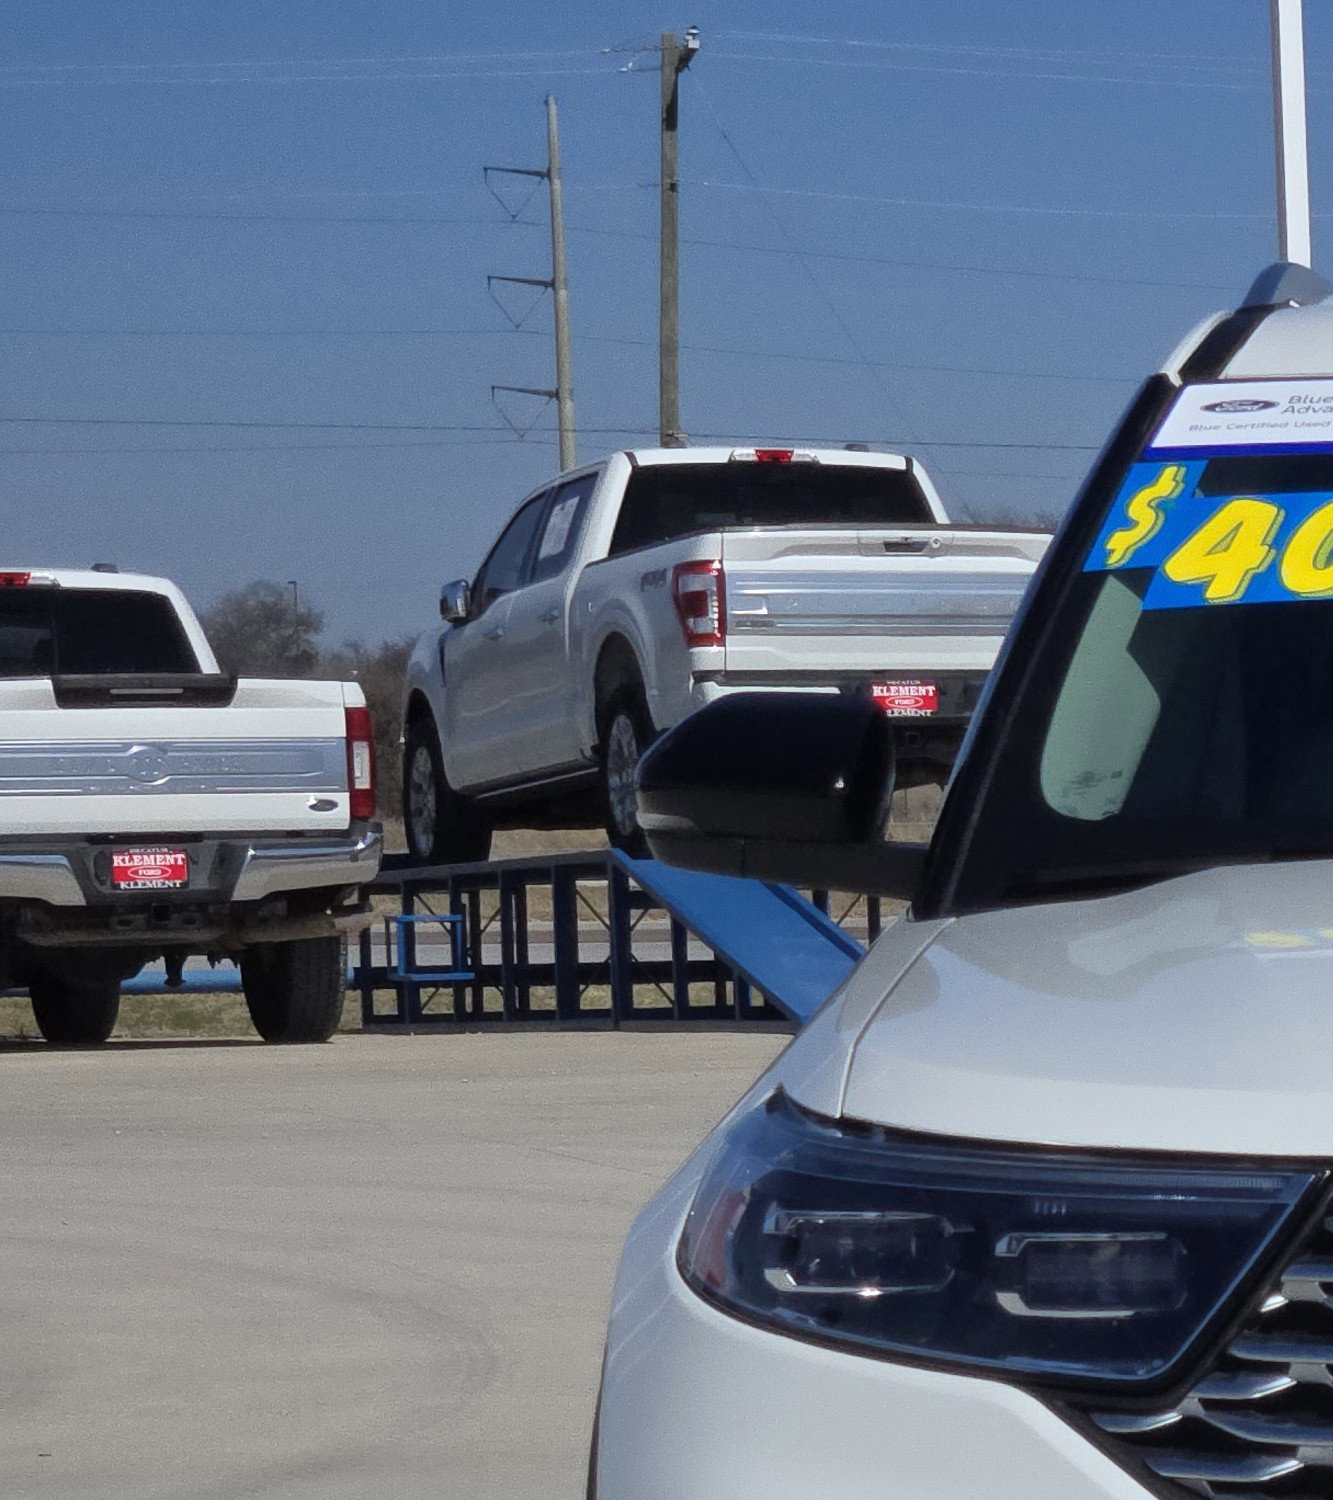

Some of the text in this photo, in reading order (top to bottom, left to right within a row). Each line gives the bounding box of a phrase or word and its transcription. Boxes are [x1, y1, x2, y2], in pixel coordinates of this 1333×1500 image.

[1226, 420, 1288, 430] Certified
[1293, 419, 1332, 429] Used
[872, 685, 936, 697] KLEMENT
[886, 708, 934, 717] LEMENT
[113, 853, 186, 867] KLEMENT
[120, 879, 182, 890] KLEMENT
